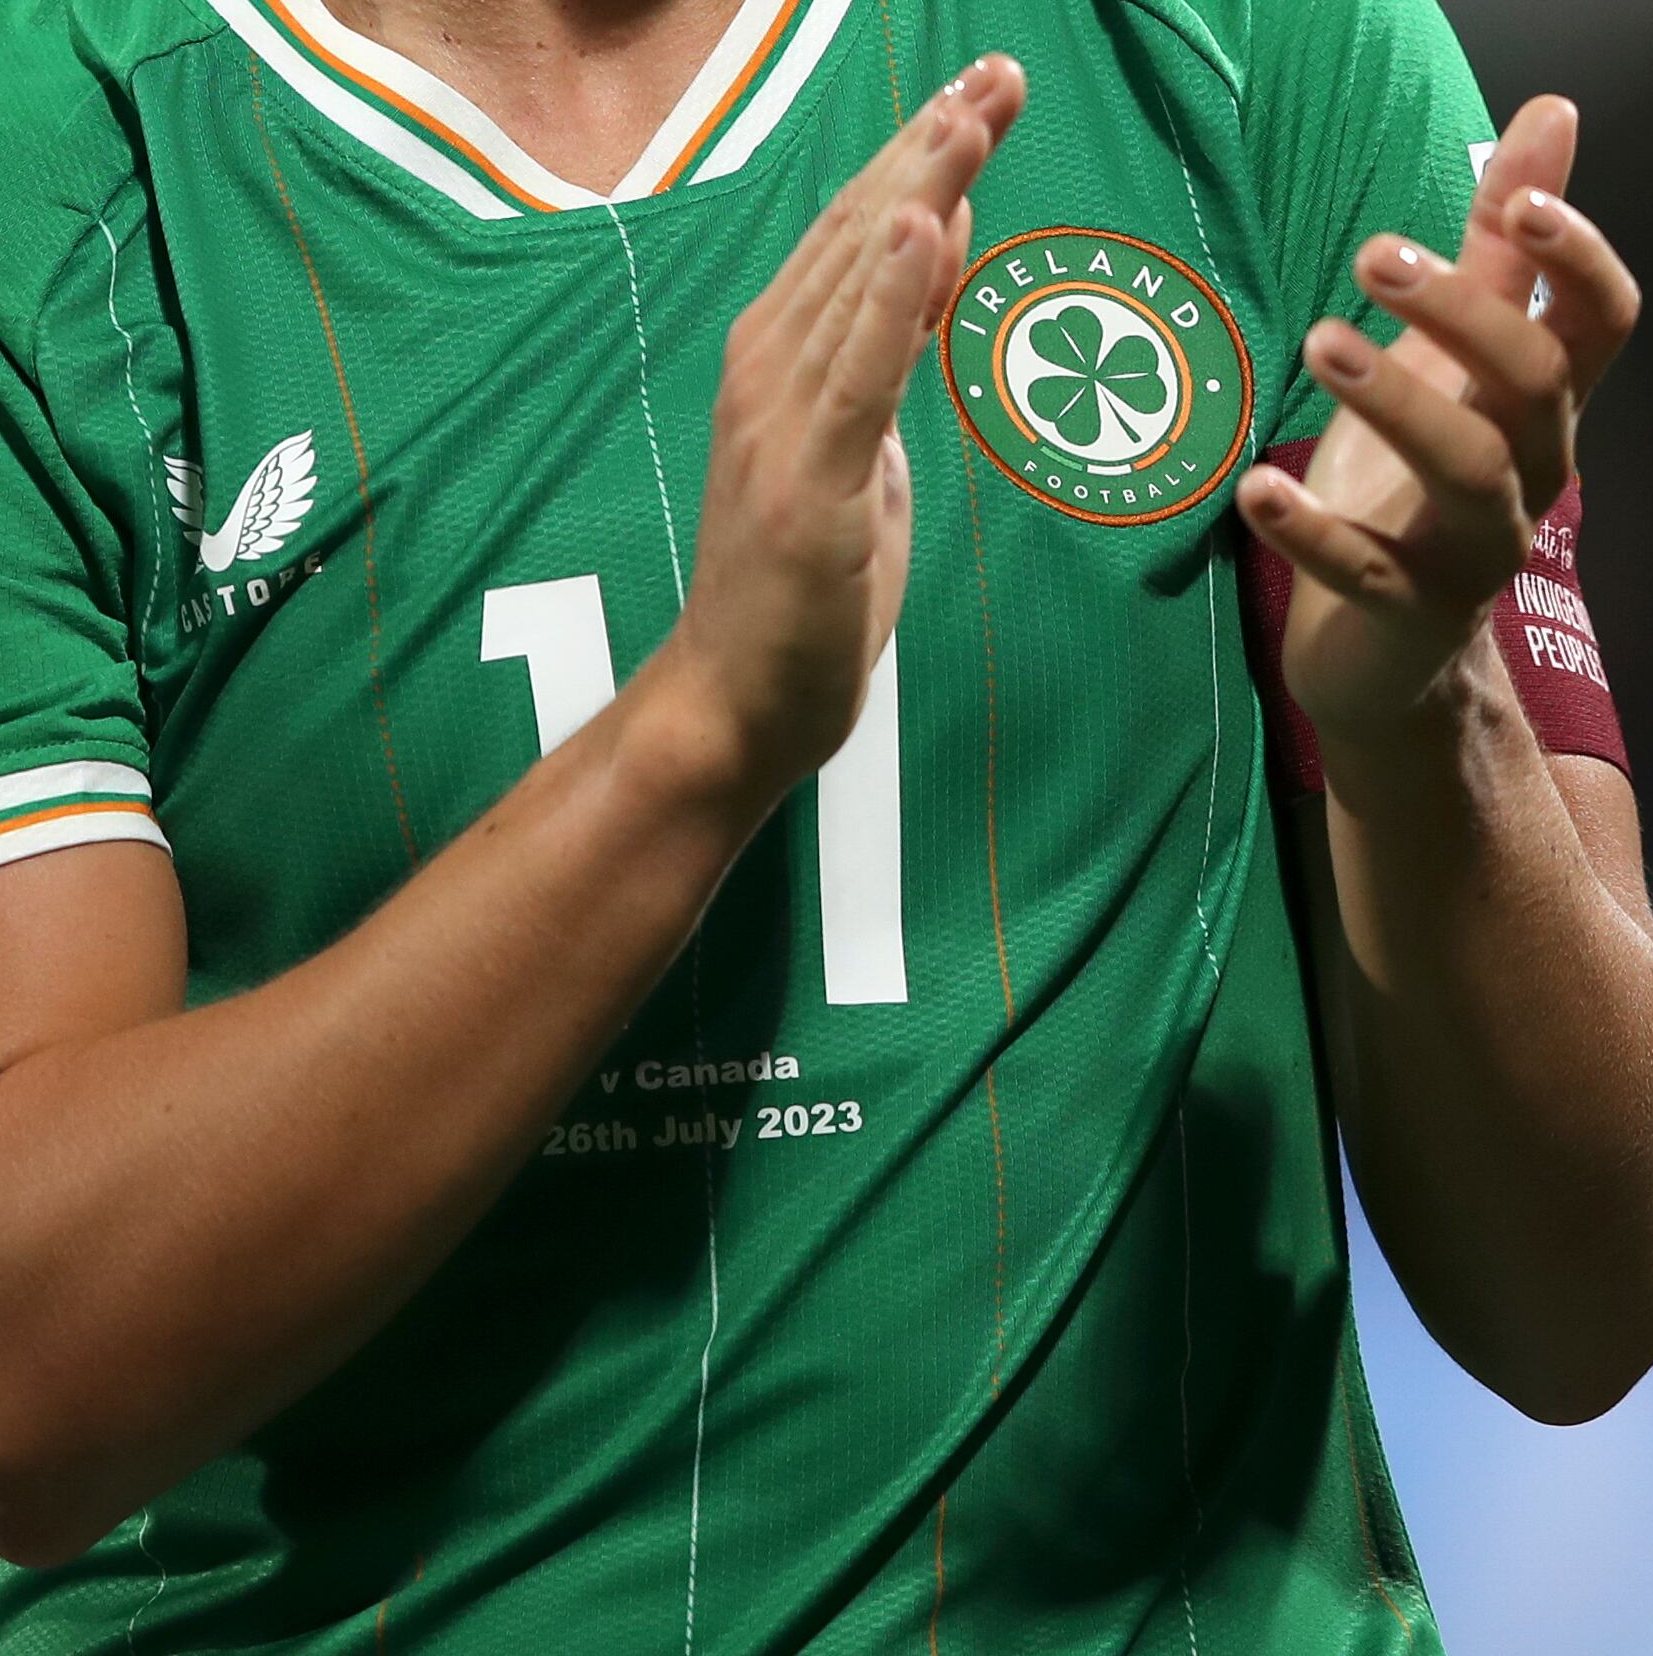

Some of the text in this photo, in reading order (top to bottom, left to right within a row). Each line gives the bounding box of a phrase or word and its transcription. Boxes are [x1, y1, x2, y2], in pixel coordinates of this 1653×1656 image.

[959, 248, 1200, 336] IRELAND
[1023, 460, 1197, 504] FOOTBALL
[600, 1051, 801, 1094] v Canada
[542, 1100, 864, 1156] 26th July 2023
